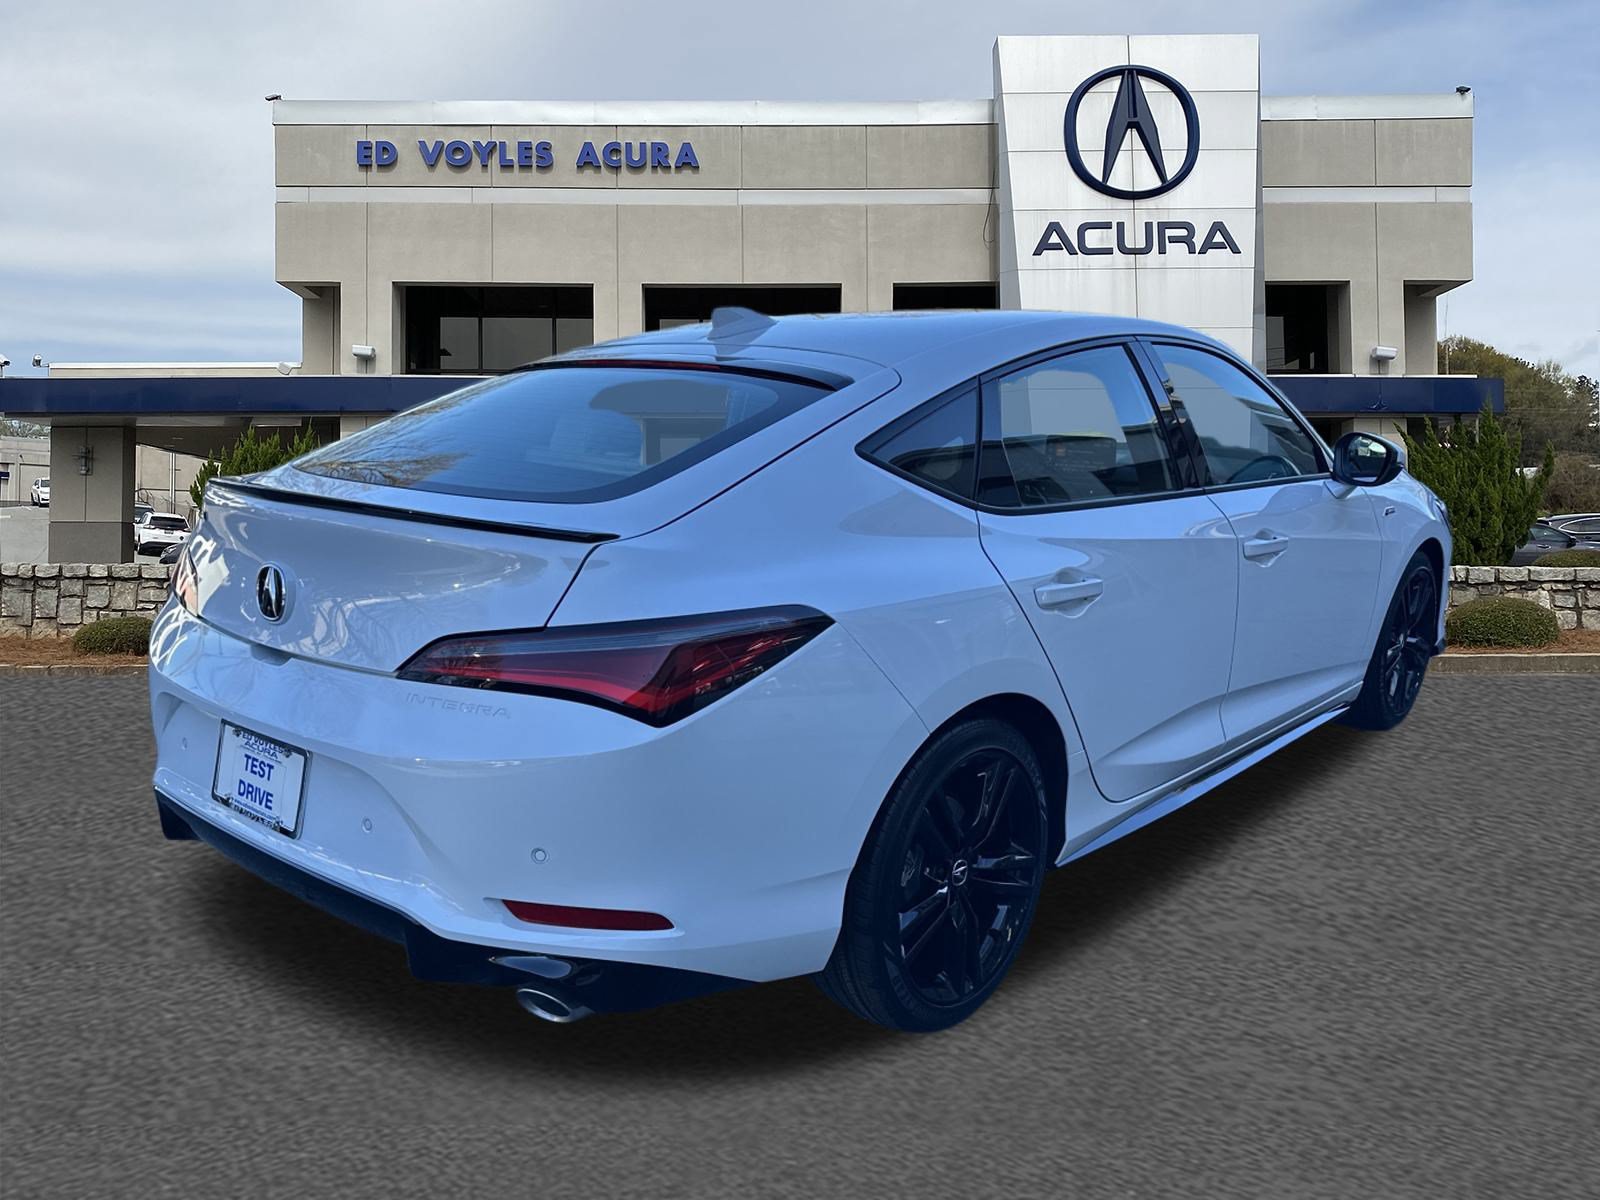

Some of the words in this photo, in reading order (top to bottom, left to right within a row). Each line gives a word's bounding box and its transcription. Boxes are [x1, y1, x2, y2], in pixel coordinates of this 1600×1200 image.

[356, 140, 398, 167] ED
[418, 140, 554, 168] VOYLES
[576, 141, 701, 168] ACURA
[1032, 221, 1242, 256] ACURA
[406, 692, 511, 719] INTEGRA
[244, 740, 279, 760] ACURA
[243, 753, 275, 781] TEST
[237, 778, 274, 811] DRIVE
